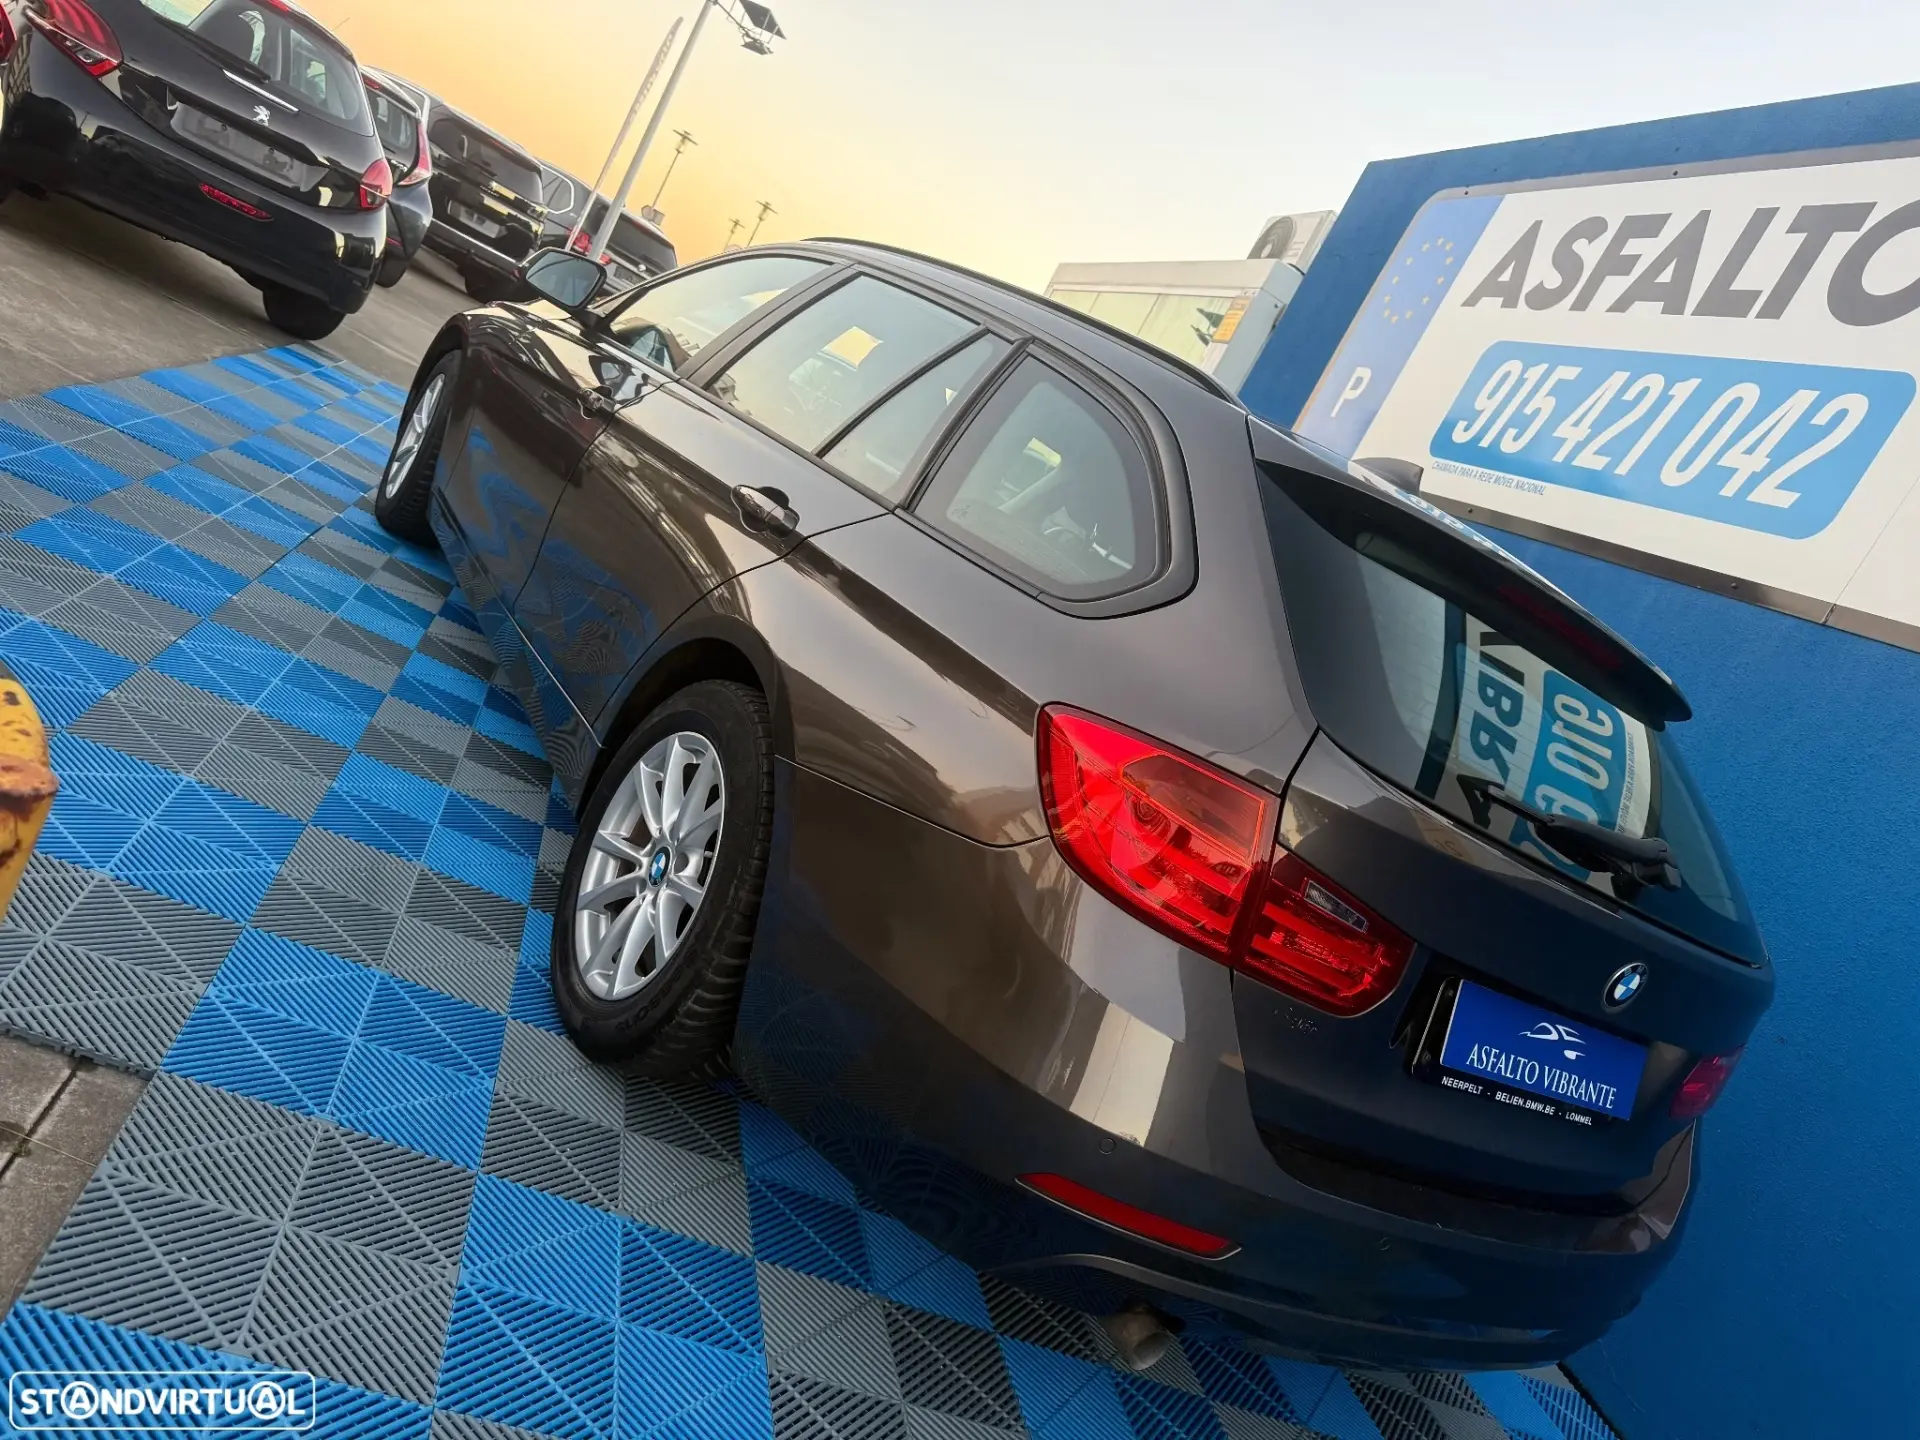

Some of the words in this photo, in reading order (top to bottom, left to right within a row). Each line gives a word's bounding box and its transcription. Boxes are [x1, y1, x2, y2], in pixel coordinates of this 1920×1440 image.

[1461, 198, 1920, 327] ASFALTO
[1330, 367, 1372, 418] P
[1452, 359, 1583, 454] 915
[1552, 371, 1702, 477] 421
[1660, 382, 1869, 509] 042
[1432, 461, 1458, 475] CHAMADA
[1458, 466, 1473, 478] PARA
[1478, 471, 1495, 484] REDE
[1514, 479, 1547, 495] NACIONAL
[1441, 1076, 1483, 1095] NEERPELT
[1495, 1091, 1556, 1116] BELIEN.BMW.BE
[1565, 1112, 1592, 1125] LOMMEL
[1466, 1043, 1539, 1085] ASFALTO
[1544, 1065, 1617, 1109] VIBRANTE
